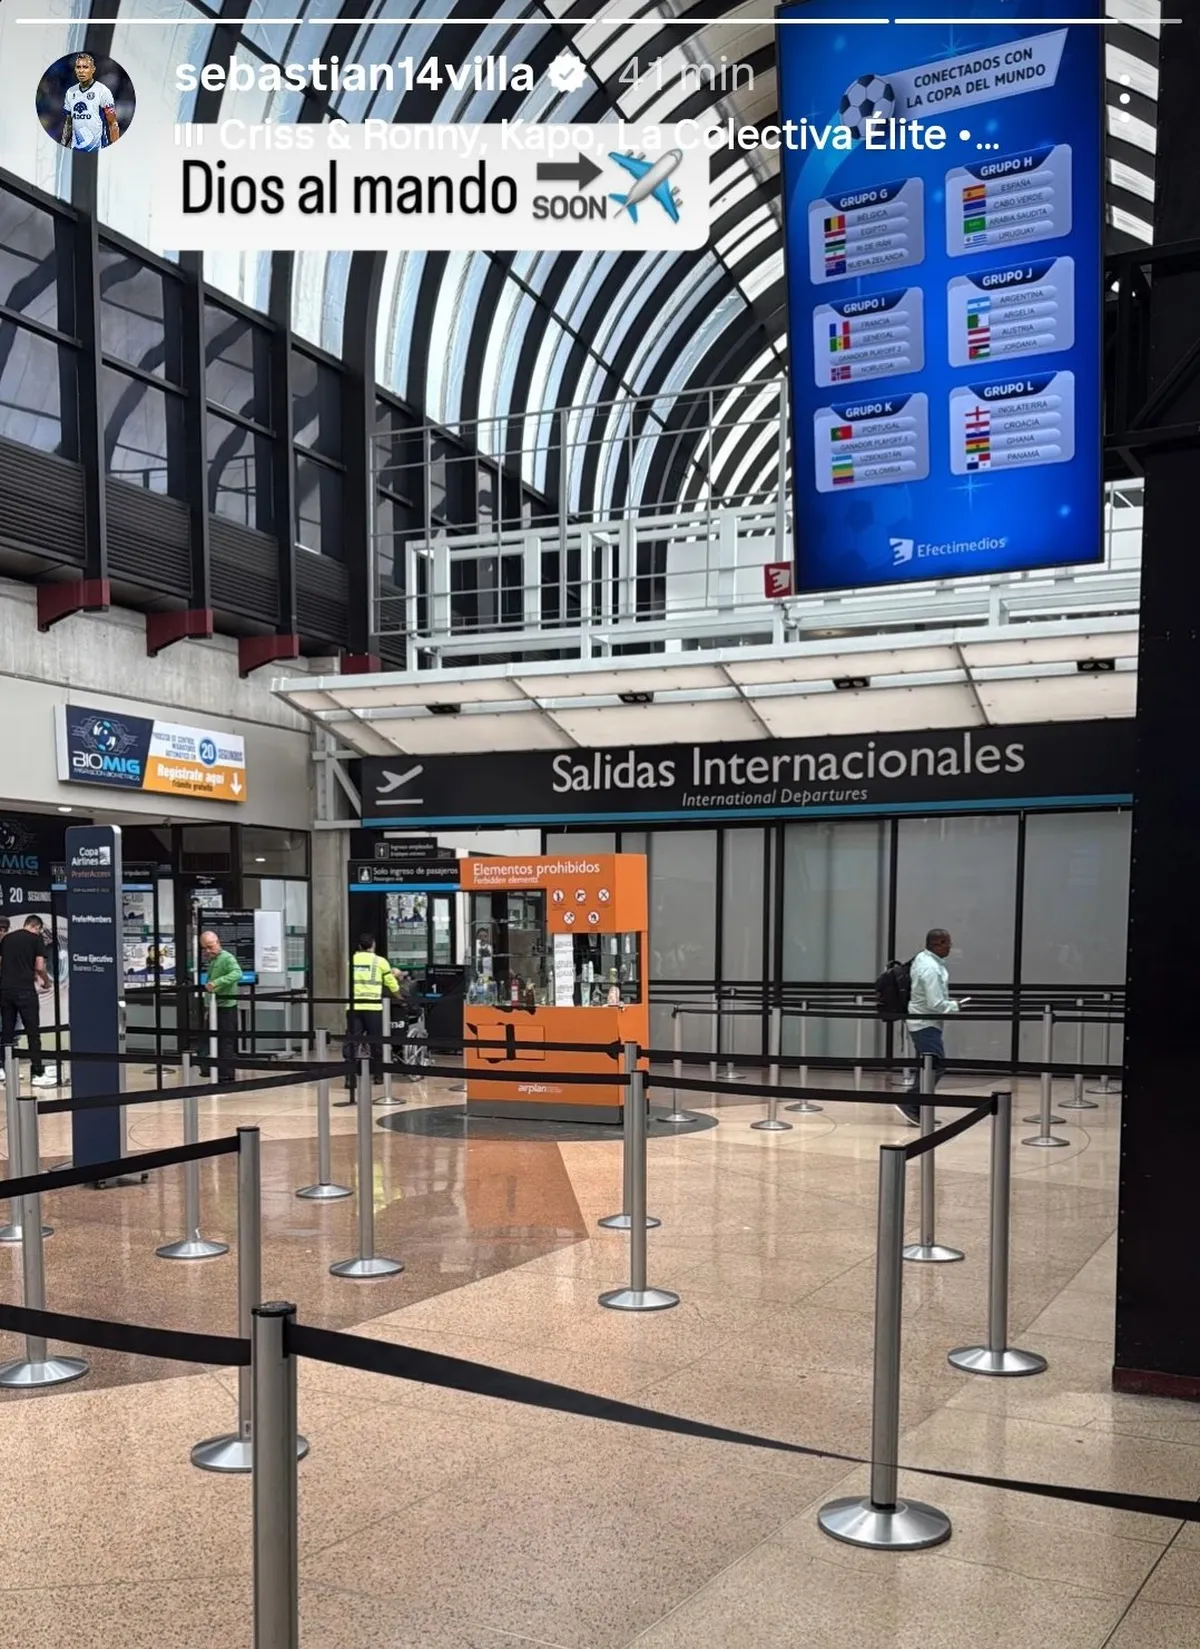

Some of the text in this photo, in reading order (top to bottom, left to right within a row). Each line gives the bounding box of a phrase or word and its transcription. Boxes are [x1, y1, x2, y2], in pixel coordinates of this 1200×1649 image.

[913, 47, 1033, 88] CONECTADOS CON
[906, 63, 1046, 109] LA COPA DEL MUNDO
[981, 156, 1033, 177] GRUPO H
[1001, 179, 1031, 192] ESPAÑA
[839, 189, 888, 208] GRUPO G
[993, 193, 1043, 210] CABO VERDE
[989, 208, 1048, 226] ARABIA SAUDITA
[860, 224, 888, 236] EGIPTO
[999, 226, 1035, 240] URUGUAY
[847, 252, 904, 269] NUEVA ZELANDA
[982, 268, 1033, 286] GRUPO J
[999, 289, 1044, 303] ARGENTINA
[843, 297, 886, 314] GRUPO I
[1003, 307, 1036, 319] ARGELIA
[1001, 324, 1034, 336] AUSTRIA
[1002, 339, 1038, 352] JORDANIA
[984, 380, 1034, 398] GRUPO L
[845, 401, 893, 419] GRUPO K
[998, 400, 1048, 414] INGLATERRA
[861, 421, 901, 433] PORTUGAL
[1003, 418, 1040, 430] CROACIA
[1006, 434, 1035, 445] GHANA
[864, 465, 902, 478] COLOMBIA
[917, 536, 1006, 558] Efectimedios
[201, 742, 214, 760] 20
[73, 750, 140, 775] BIOMIG
[552, 731, 1026, 793] Salidas Internacionales
[682, 787, 868, 807] International Departures
[79, 847, 99, 858] Copa
[71, 857, 99, 867] Airlines
[473, 860, 600, 877] Elementos prohibidos
[390, 868, 415, 877] ingreso
[416, 866, 424, 875] de
[426, 868, 458, 877] pasajeros
[9, 887, 24, 903] 20
